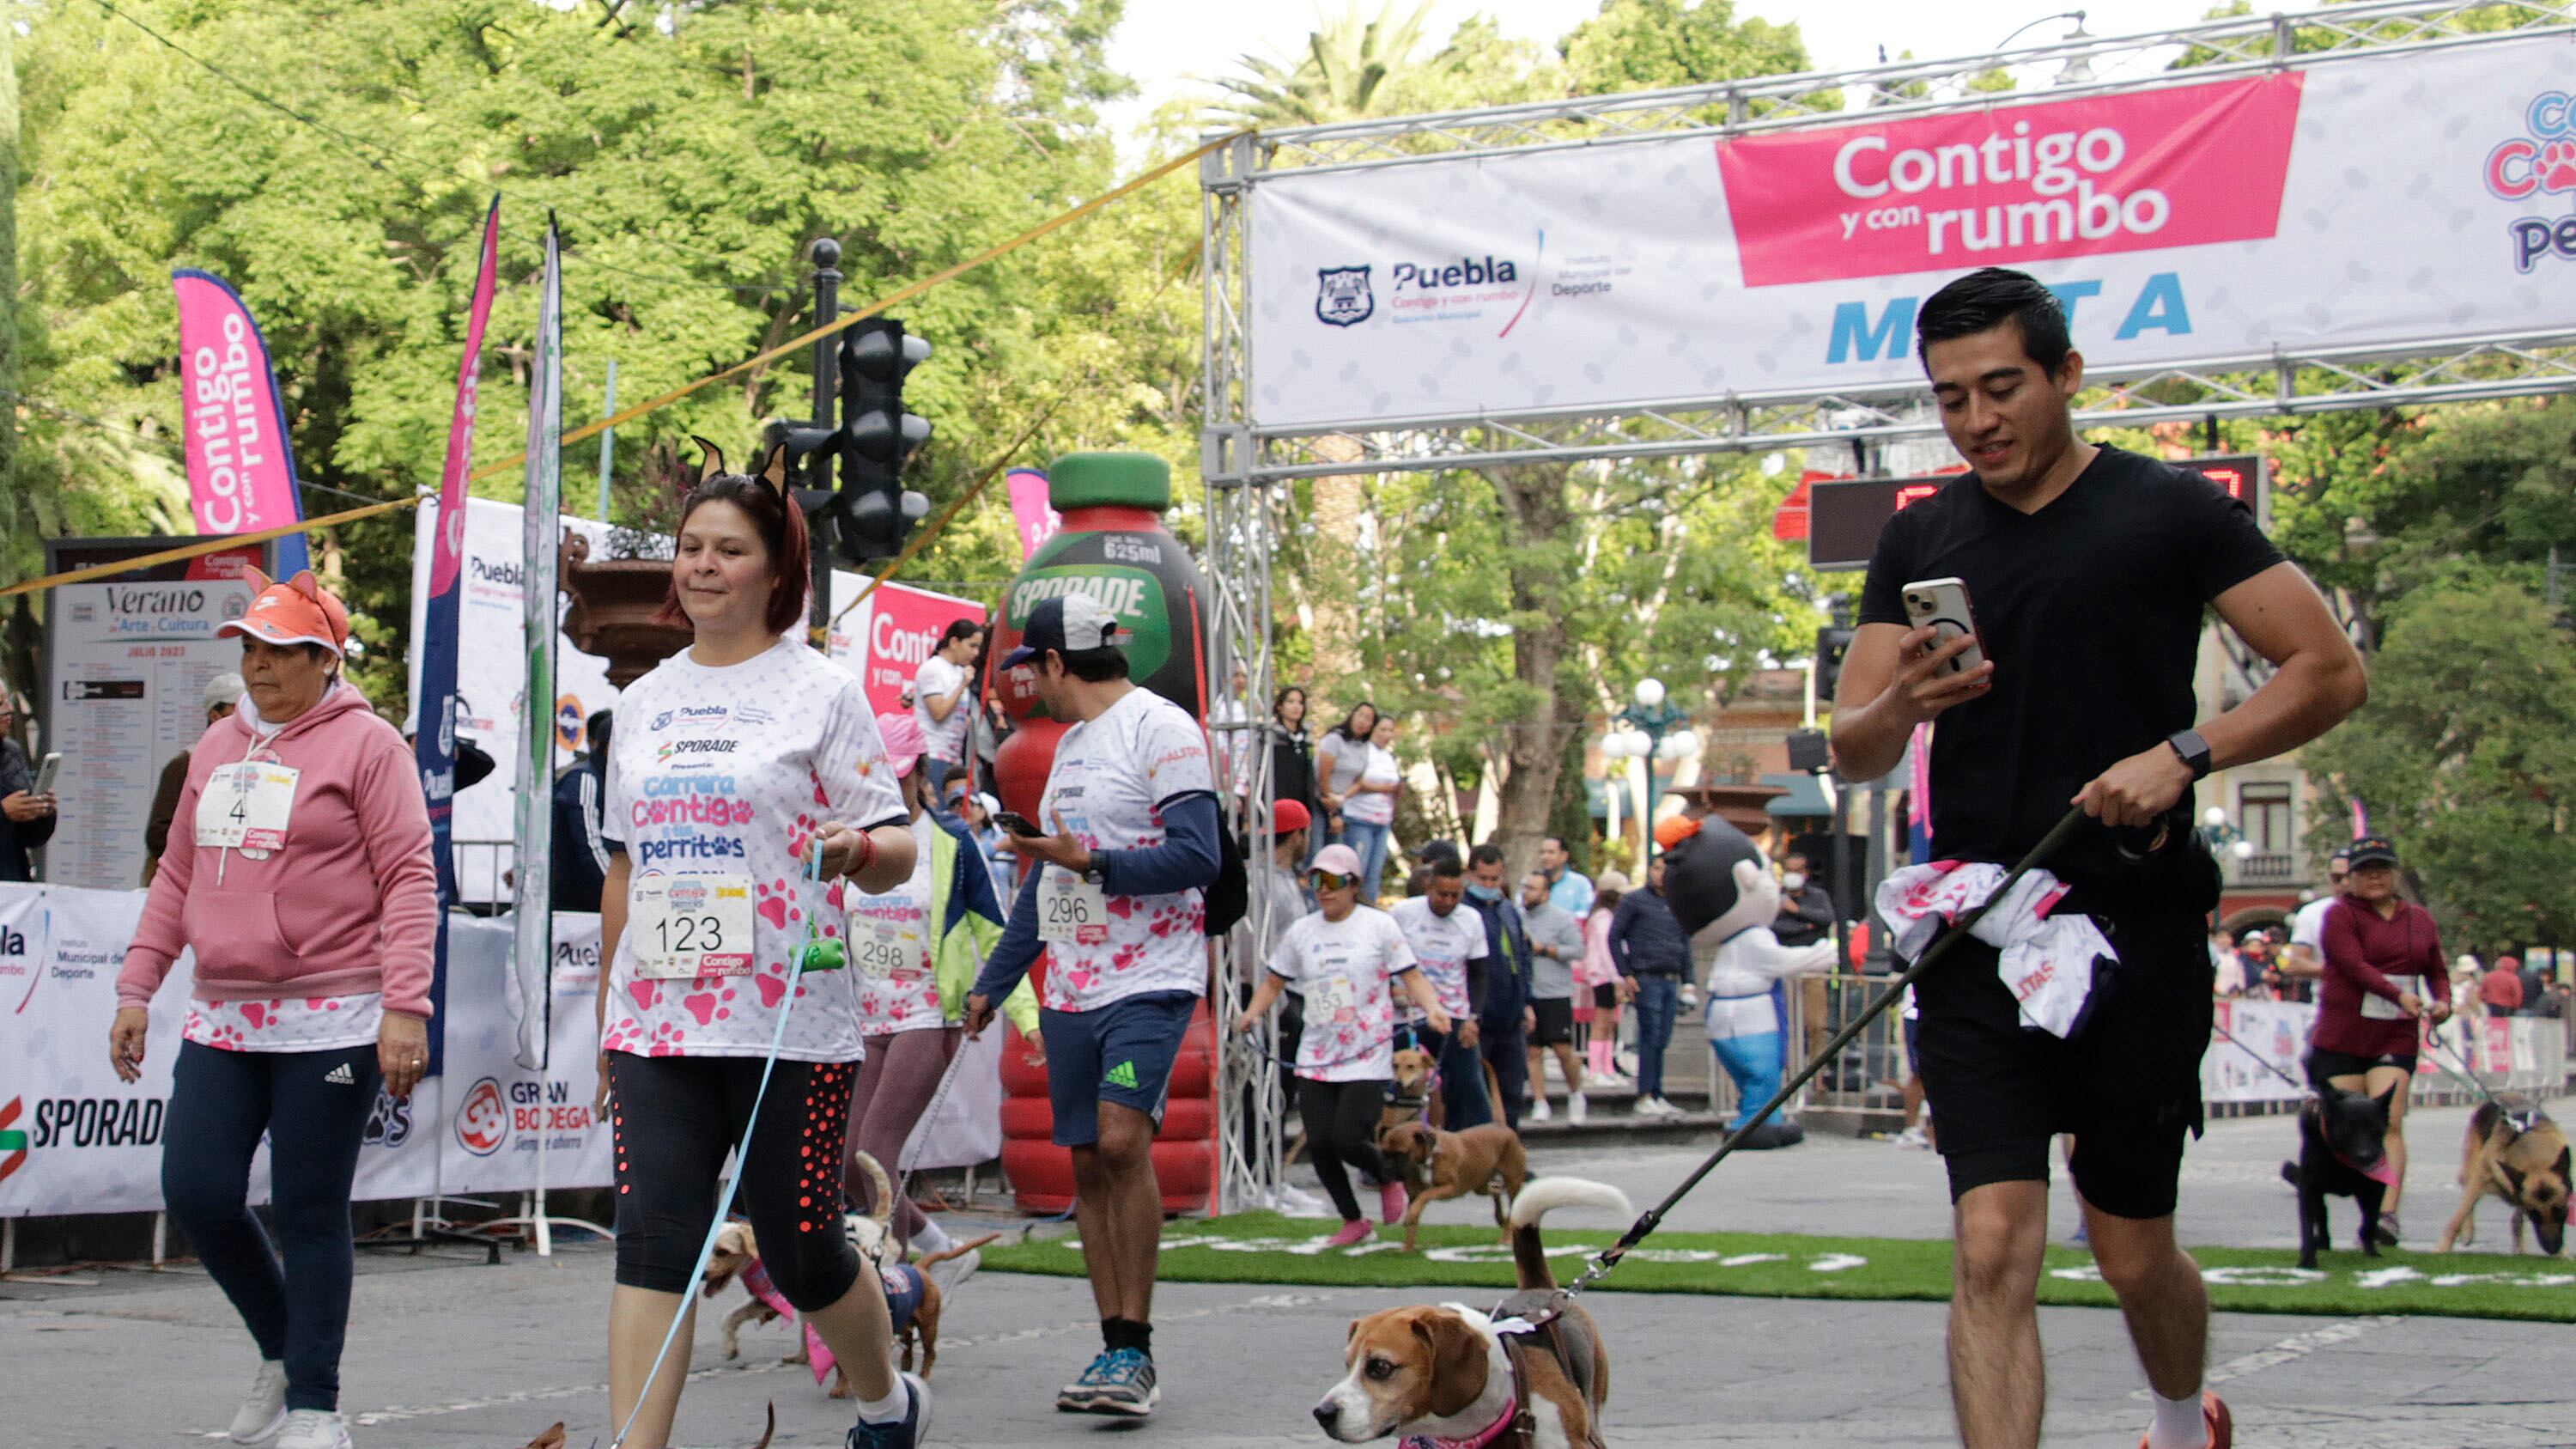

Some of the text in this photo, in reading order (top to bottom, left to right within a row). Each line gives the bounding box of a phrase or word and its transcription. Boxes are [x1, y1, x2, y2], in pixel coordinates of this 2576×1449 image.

[1832, 120, 2127, 198] Contigo
[1839, 177, 2171, 256] y con rumbo
[1393, 255, 1518, 290] Puebla
[1392, 295, 1438, 310] Contigo
[1475, 289, 1518, 302] rumbo
[1552, 282, 1613, 297] Deporte
[1826, 272, 2193, 364] MTA
[220, 313, 264, 526] y con rumbo
[193, 346, 242, 535] Contigo
[1104, 541, 1162, 564] 625ml
[106, 587, 205, 613] Verano
[118, 618, 149, 631] Arte
[158, 617, 209, 631] Cultura
[679, 704, 728, 717] Puebla
[674, 740, 738, 753] SPORADE
[229, 798, 245, 825] 4
[1048, 897, 1089, 923] 296
[655, 916, 723, 953] 123
[57, 951, 108, 966] Municipal
[703, 955, 744, 969] Contigo
[862, 941, 904, 968] 298
[52, 965, 94, 980] Deporte
[33, 1099, 169, 1148] SPORAD
